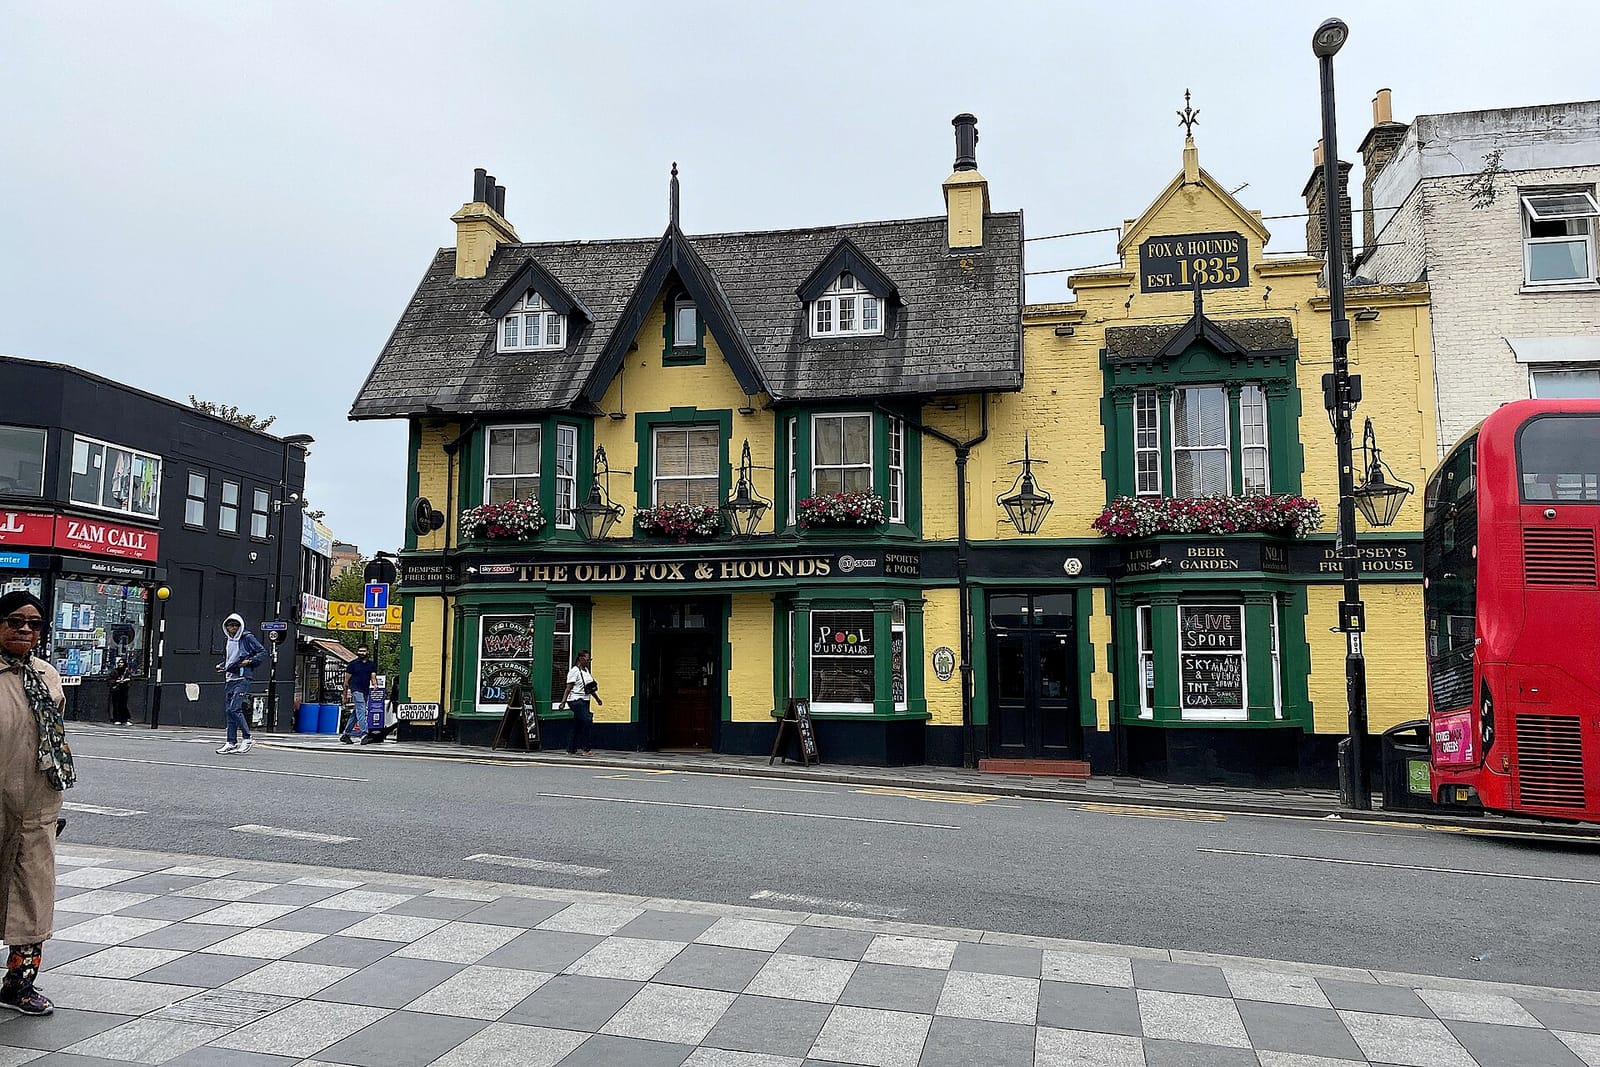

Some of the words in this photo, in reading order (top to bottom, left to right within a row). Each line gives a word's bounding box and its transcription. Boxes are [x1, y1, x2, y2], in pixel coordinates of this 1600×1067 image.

[1148, 242, 1172, 258] FOX
[1175, 241, 1185, 256] &
[1188, 238, 1239, 256] HOUNDS
[1147, 273, 1175, 288] EST.
[1176, 255, 1241, 286] 1835
[66, 521, 105, 544] ZAM
[107, 528, 147, 550] CALL
[1130, 548, 1152, 560] LIVE
[1187, 547, 1225, 557] BEER
[854, 559, 877, 568] SPORT
[885, 553, 919, 564] SPORTS
[515, 565, 568, 582] THE
[574, 564, 626, 582] OLD
[632, 562, 685, 581] FOX
[694, 561, 713, 580] &
[719, 557, 831, 579] HOUNDS
[885, 564, 892, 573] &
[894, 564, 920, 575] POOL
[1179, 559, 1239, 570] GARDEN
[1362, 560, 1414, 571] HOUSE
[337, 603, 363, 617] CAS
[1193, 613, 1232, 631] LIVE
[1187, 630, 1235, 647] SPORT
[1186, 659, 1212, 670] SKY
[1195, 670, 1203, 680] &
[1187, 682, 1209, 693] TNT
[400, 710, 435, 720] CROYDON
